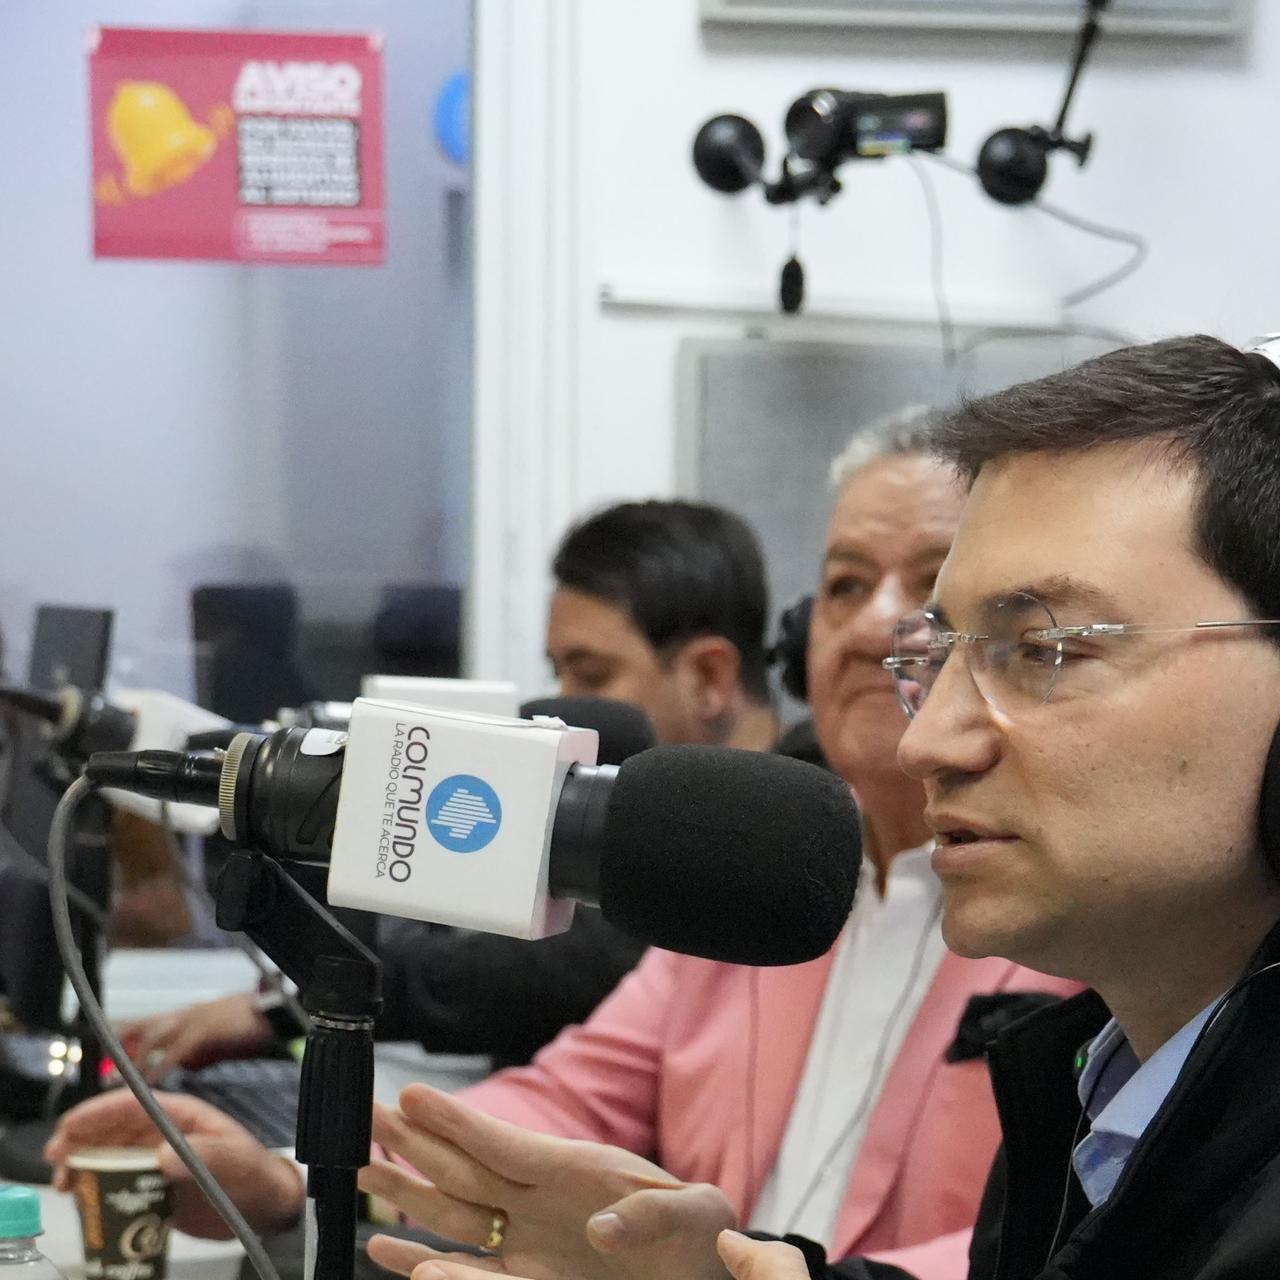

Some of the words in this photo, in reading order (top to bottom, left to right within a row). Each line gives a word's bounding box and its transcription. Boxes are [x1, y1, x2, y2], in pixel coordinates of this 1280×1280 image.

[394, 722, 407, 738] LA
[388, 739, 404, 780] RADIO
[384, 782, 399, 811] QUE
[381, 811, 394, 827] TE
[375, 828, 391, 879] ACERCA
